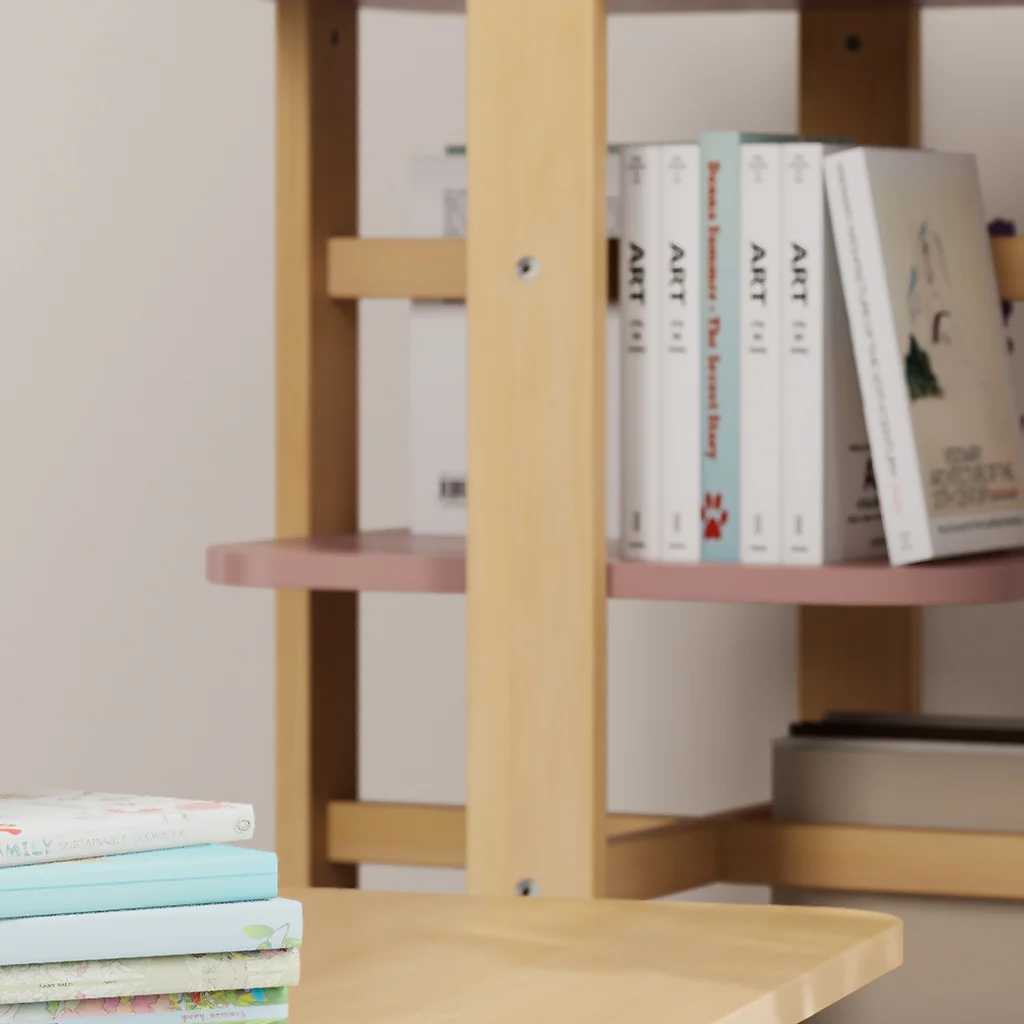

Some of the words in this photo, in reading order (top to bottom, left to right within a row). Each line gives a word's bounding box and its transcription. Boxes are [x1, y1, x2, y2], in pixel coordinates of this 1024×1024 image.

[628, 241, 647, 307] ART
[668, 241, 687, 307] ART
[750, 241, 768, 307] ART
[791, 241, 809, 307] ART
[707, 316, 722, 348] The
[57, 833, 128, 852] SUSTAINABLE
